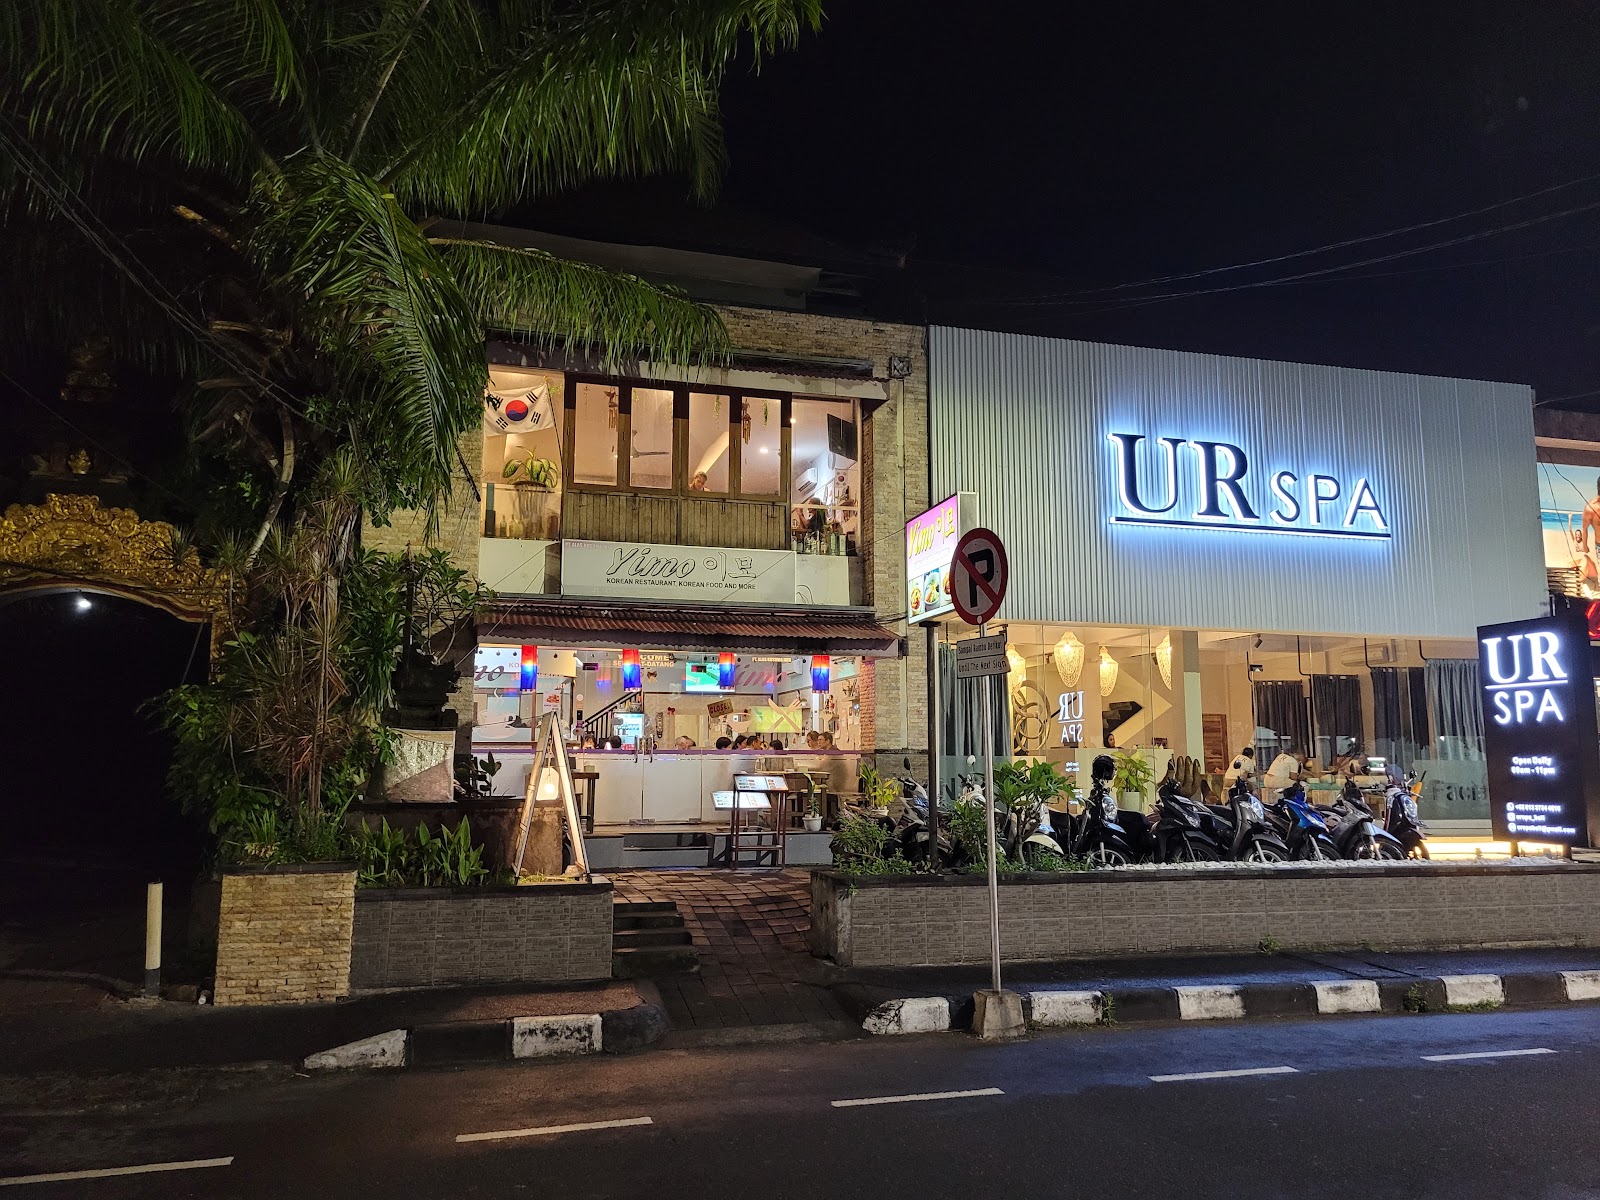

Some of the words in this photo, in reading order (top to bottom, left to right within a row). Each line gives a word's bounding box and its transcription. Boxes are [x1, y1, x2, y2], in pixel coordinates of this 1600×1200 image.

[1106, 432, 1261, 522] UR
[1269, 470, 1389, 530] SPA
[908, 520, 935, 559] Yimo
[605, 547, 696, 578] Yimo
[606, 577, 634, 585] KOREAN
[678, 580, 705, 588] KOREAN
[958, 662, 970, 673] Until
[970, 661, 979, 671] The
[980, 660, 991, 670] Next
[993, 659, 1007, 670] Sign
[1481, 631, 1568, 684] UR
[1493, 688, 1564, 725] SPA
[1512, 756, 1532, 766] Open
[1532, 756, 1552, 766] Daily
